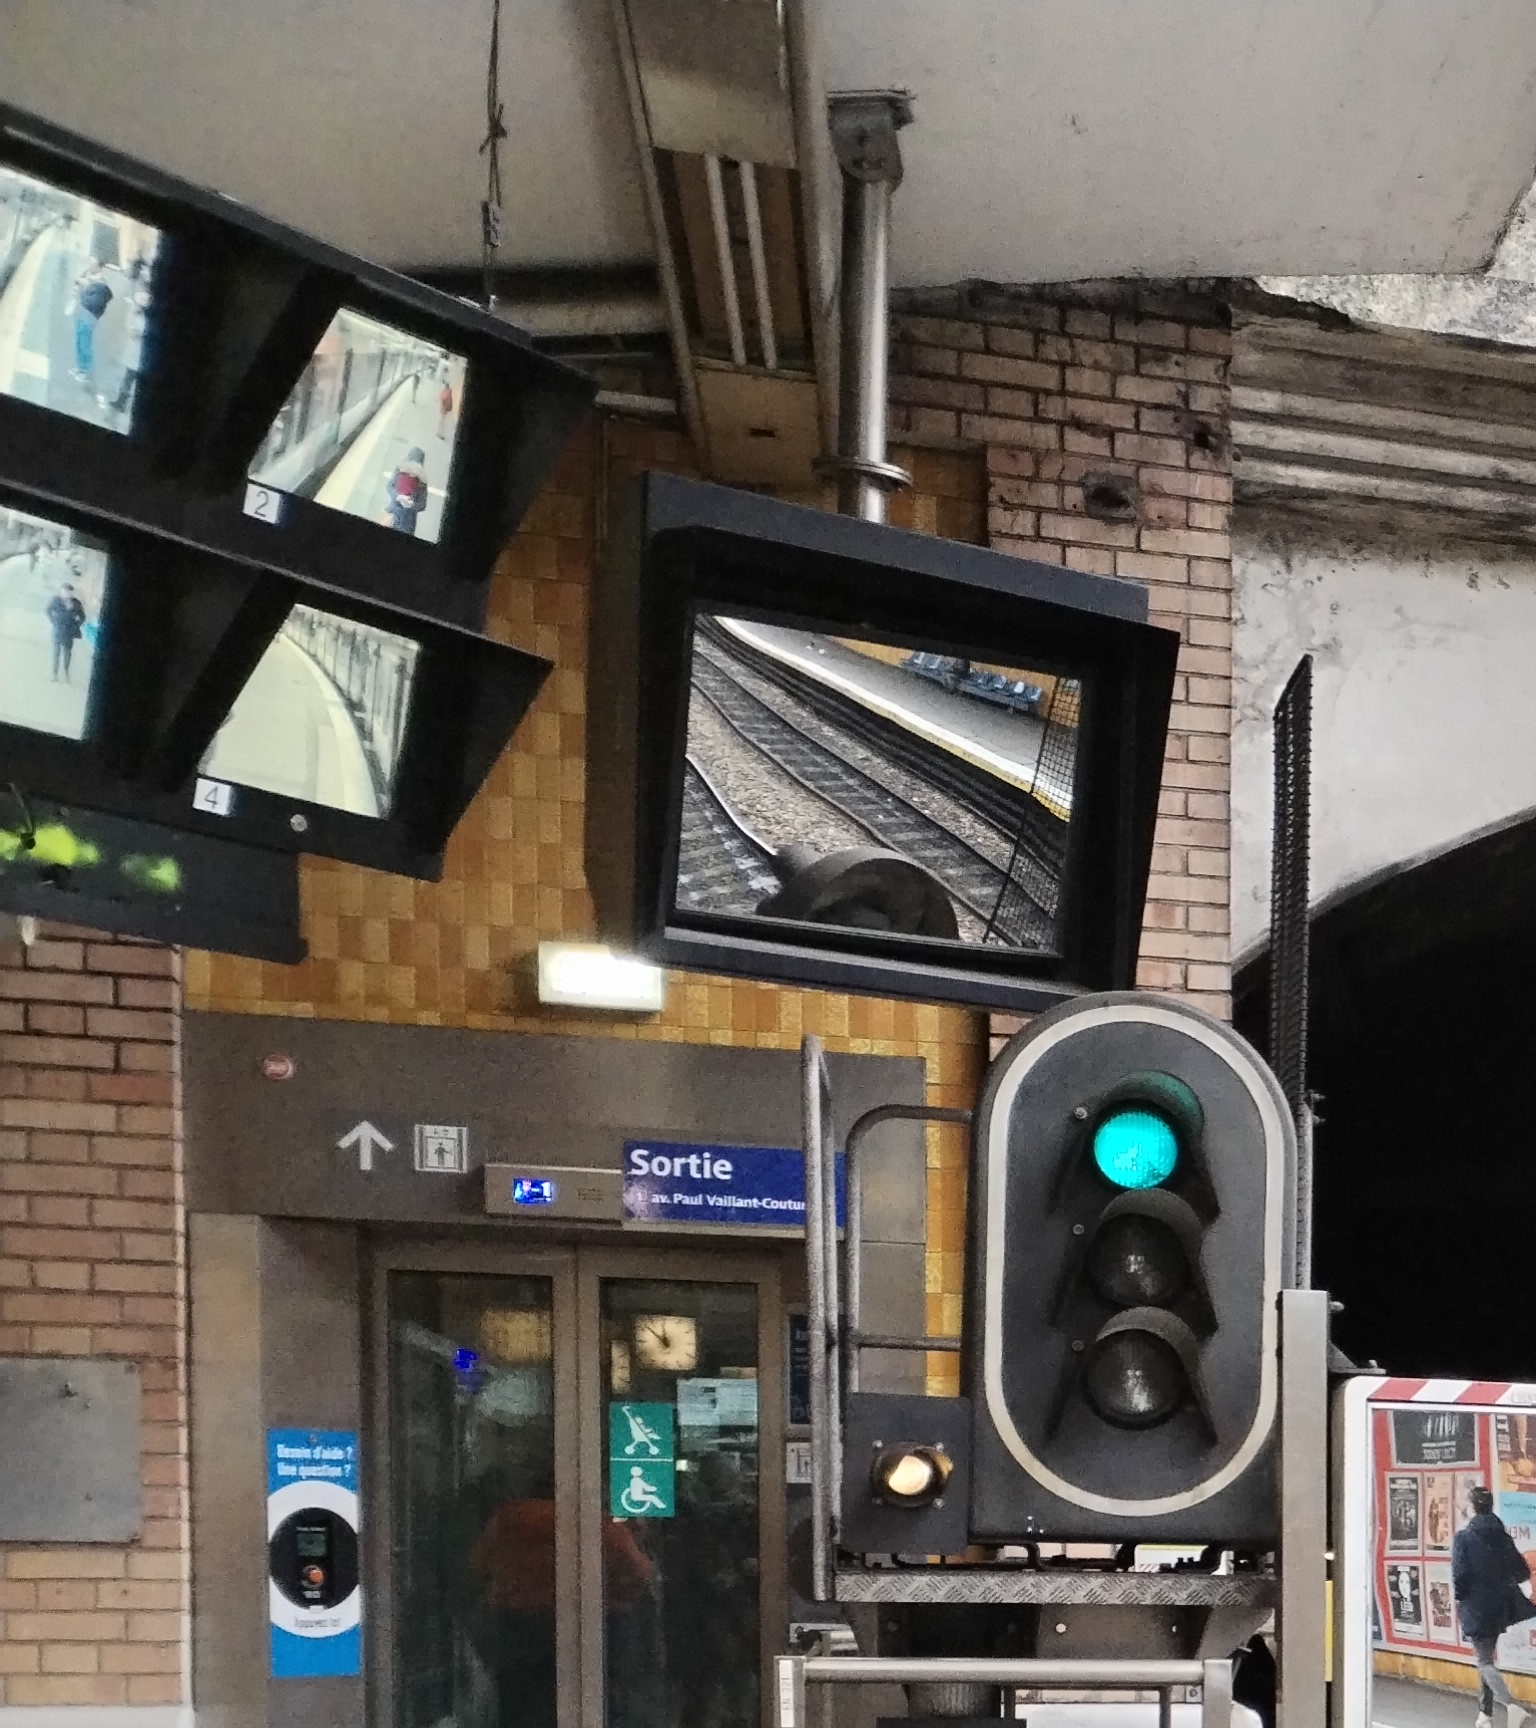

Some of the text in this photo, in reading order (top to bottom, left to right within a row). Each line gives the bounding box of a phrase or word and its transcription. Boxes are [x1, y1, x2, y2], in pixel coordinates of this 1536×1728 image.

[254, 490, 269, 518] 2
[203, 786, 219, 809] 4
[630, 1148, 733, 1180] Sortie
[651, 1194, 671, 1204] av.
[673, 1193, 703, 1206] Paul
[706, 1194, 806, 1211] Vaillant-Coutur
